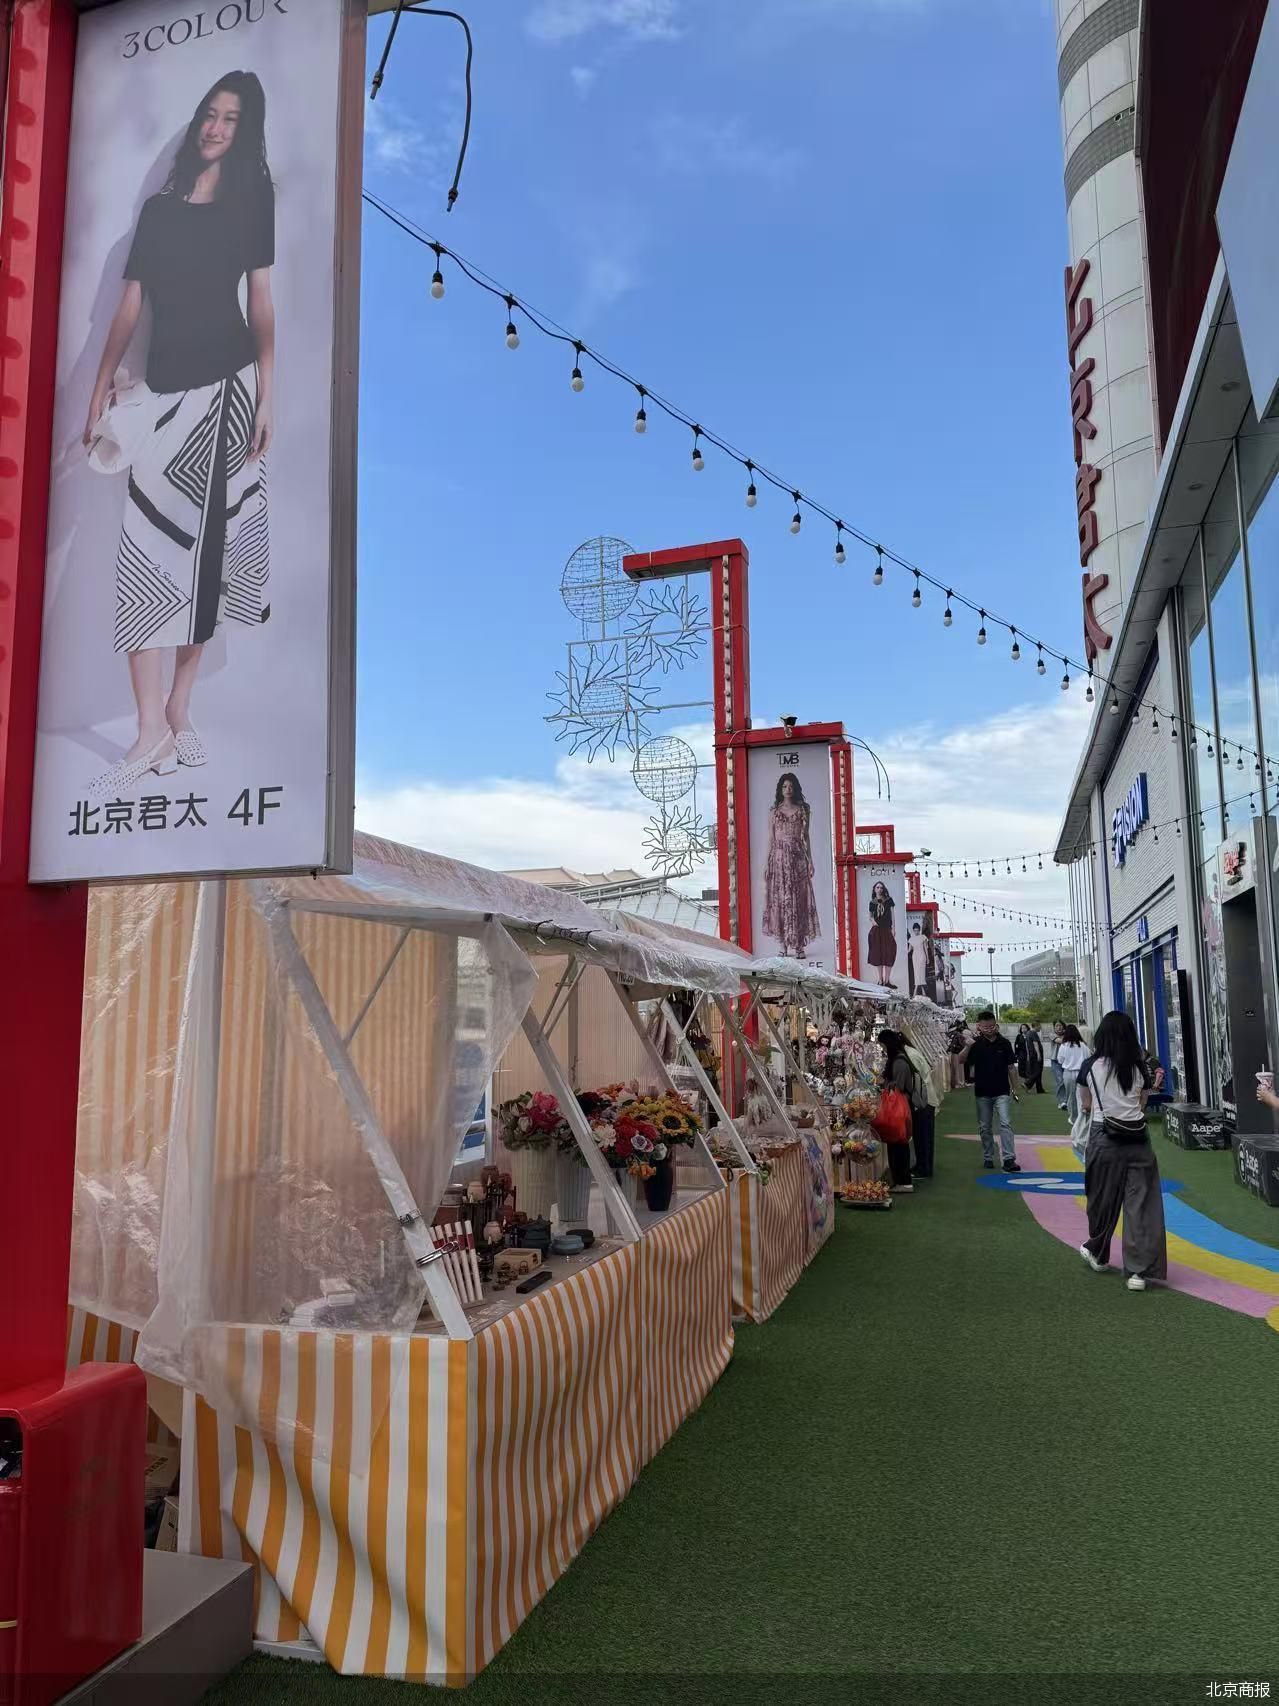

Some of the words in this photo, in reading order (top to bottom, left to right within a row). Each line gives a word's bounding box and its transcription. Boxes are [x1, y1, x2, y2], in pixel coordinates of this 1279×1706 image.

[68, 792, 208, 836] 北京君太
[227, 786, 284, 826] 4F
[1191, 1123, 1221, 1135] Aape
